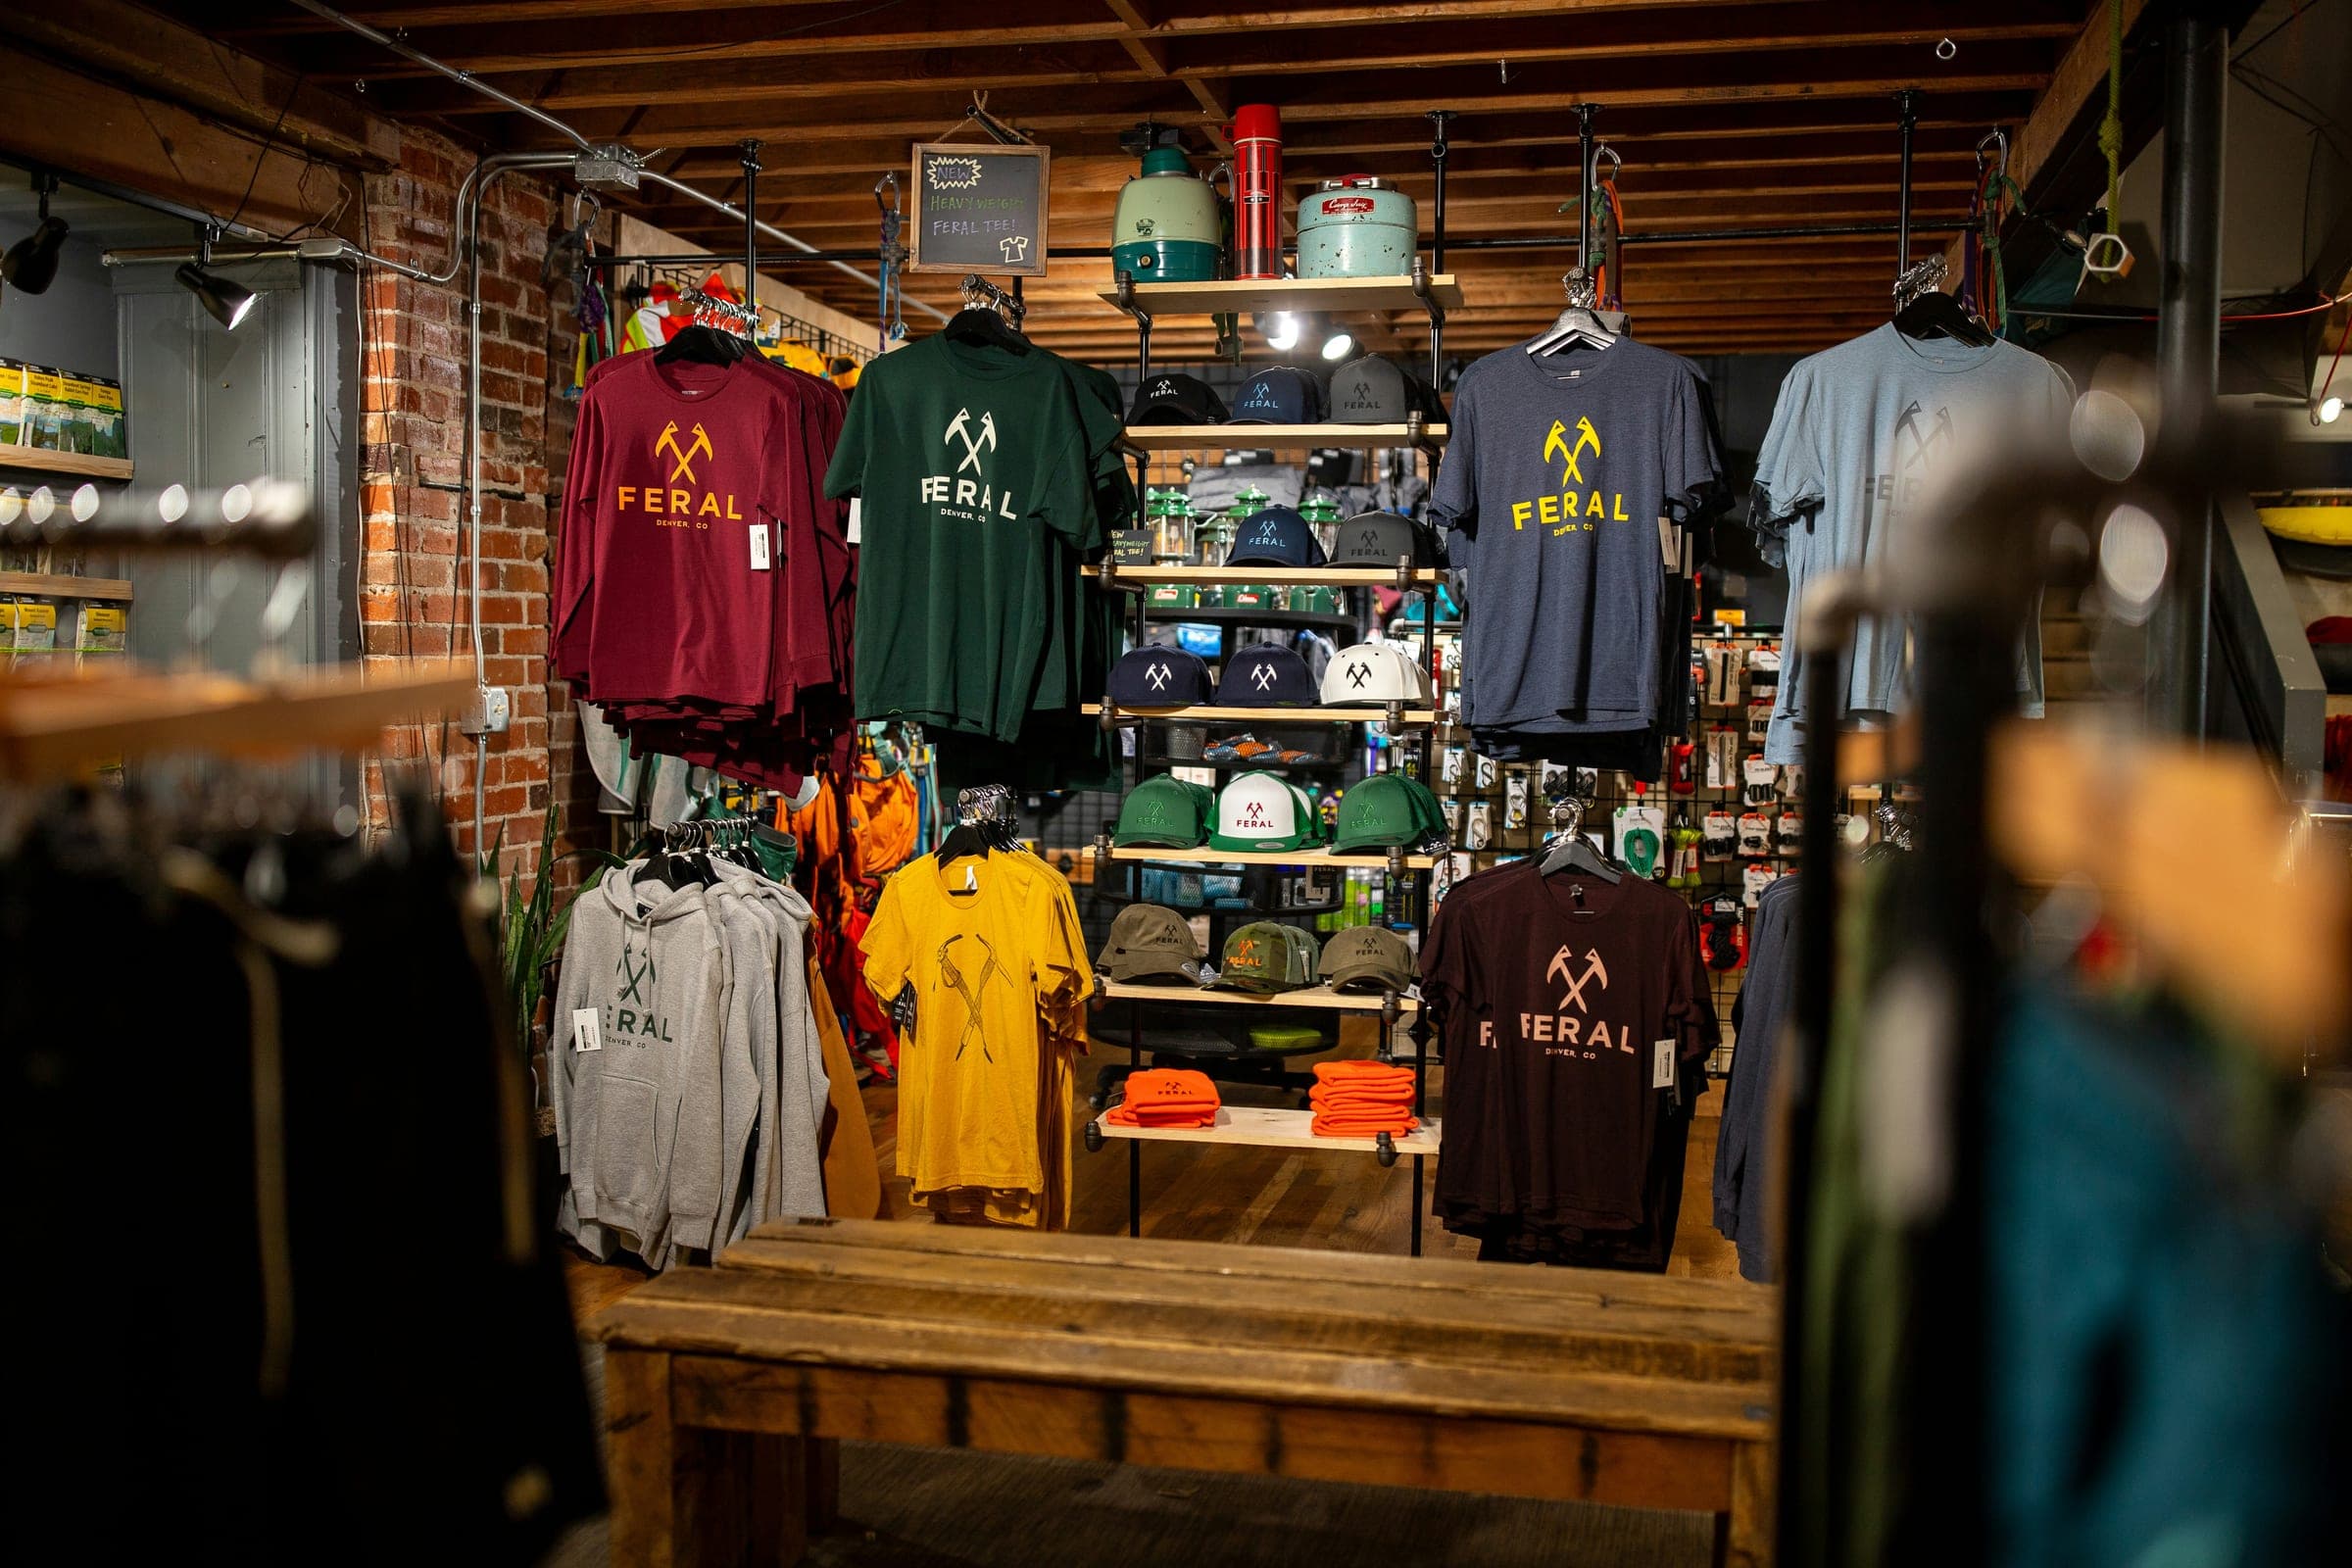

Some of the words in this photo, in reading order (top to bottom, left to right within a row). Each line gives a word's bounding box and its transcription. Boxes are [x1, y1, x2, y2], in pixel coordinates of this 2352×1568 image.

[937, 167, 971, 179] NEW
[933, 220, 979, 235] FERAL
[983, 219, 1015, 233] TEE!
[1151, 388, 1179, 399] FERAL
[1244, 399, 1278, 409] FERAL
[1344, 400, 1381, 410] FERAL
[618, 486, 742, 520] FERAL
[921, 475, 1017, 520] FERAL
[1511, 490, 1630, 530] FERAL
[977, 514, 986, 523] CO
[1249, 537, 1286, 548] FERAL
[1127, 548, 1144, 557] TEE!
[1137, 816, 1175, 827] FERAL
[1237, 819, 1274, 828] FERAL
[1350, 818, 1387, 830] FERAL
[1155, 936, 1184, 946] FERAL
[1355, 948, 1385, 956] FERAL
[1520, 1012, 1635, 1054] FERAL
